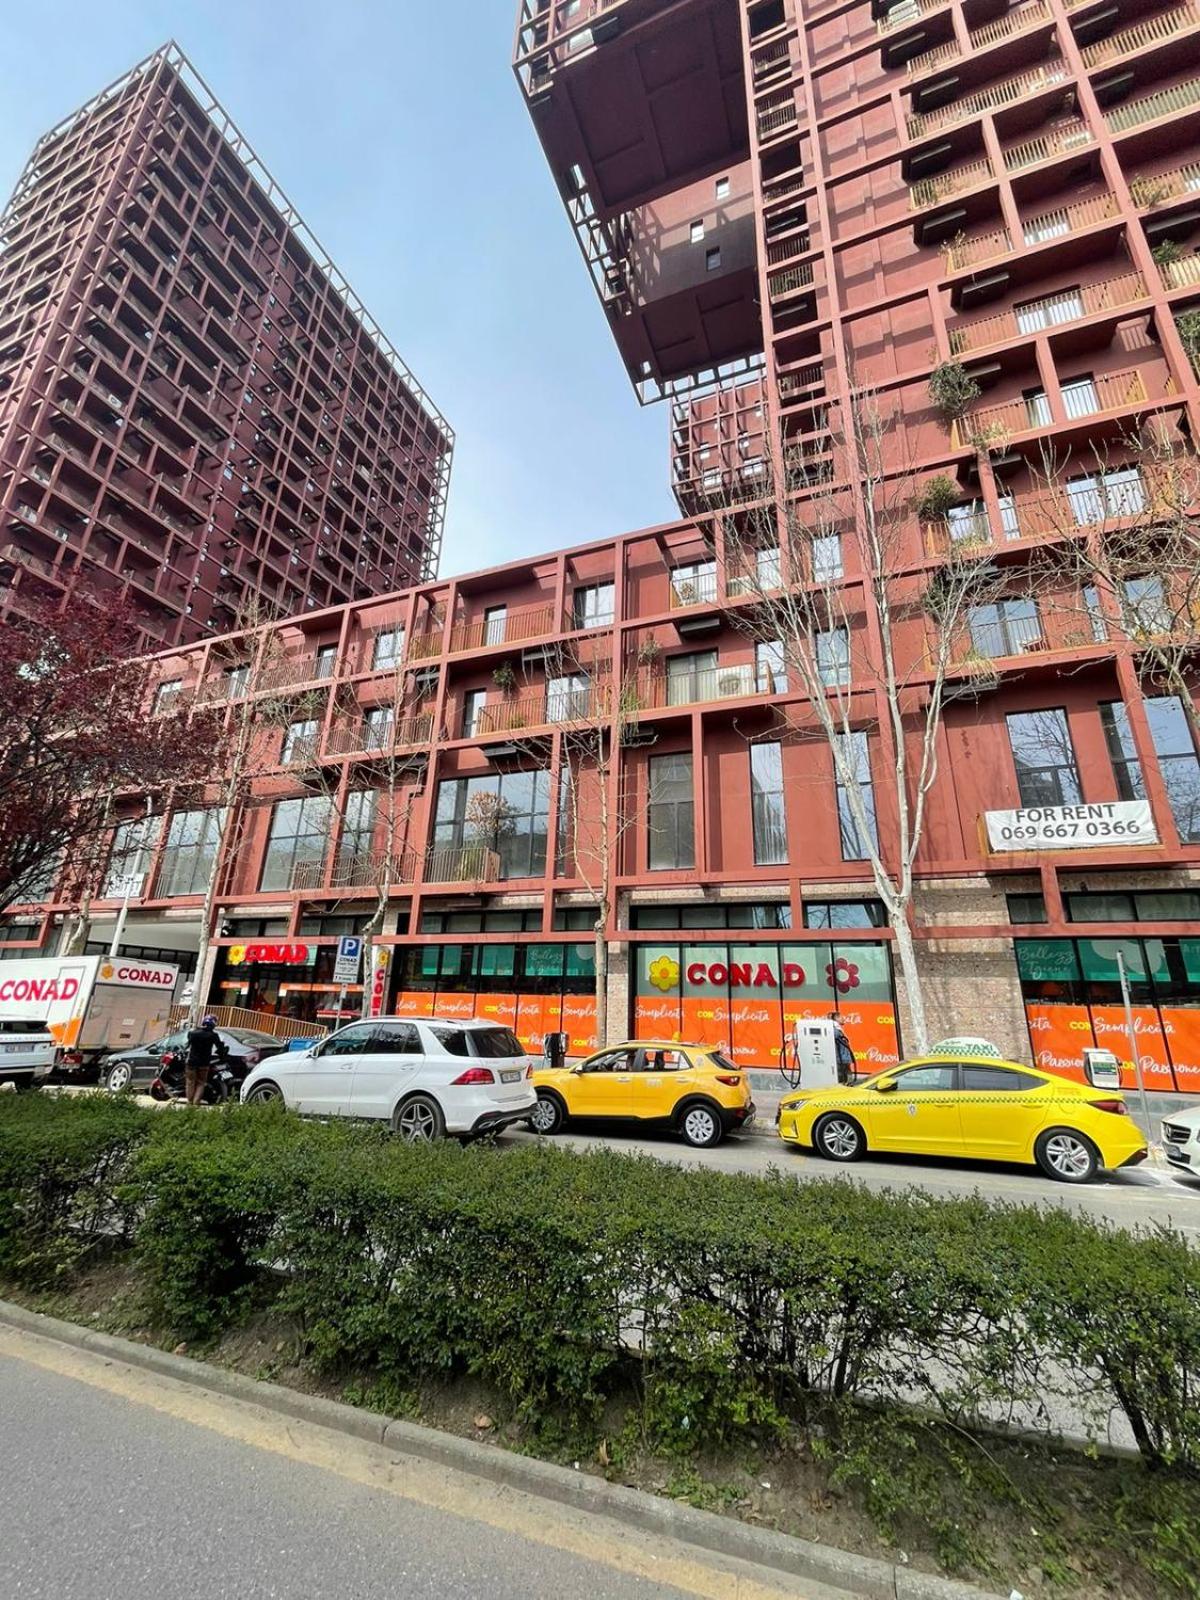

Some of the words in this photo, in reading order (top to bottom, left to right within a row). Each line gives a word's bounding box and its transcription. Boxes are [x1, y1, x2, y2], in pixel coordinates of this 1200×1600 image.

[1016, 807, 1057, 823] FOR
[1061, 804, 1116, 821] RENT
[1001, 825, 1037, 840] 069
[1043, 823, 1079, 838] 667
[1086, 820, 1140, 836] 0366
[245, 944, 309, 963] CONAD
[344, 939, 357, 955] P
[118, 967, 174, 985] CONAD
[687, 962, 806, 988] CONAD
[0, 978, 79, 1002] CONAD
[965, 1043, 993, 1051] TAXI
